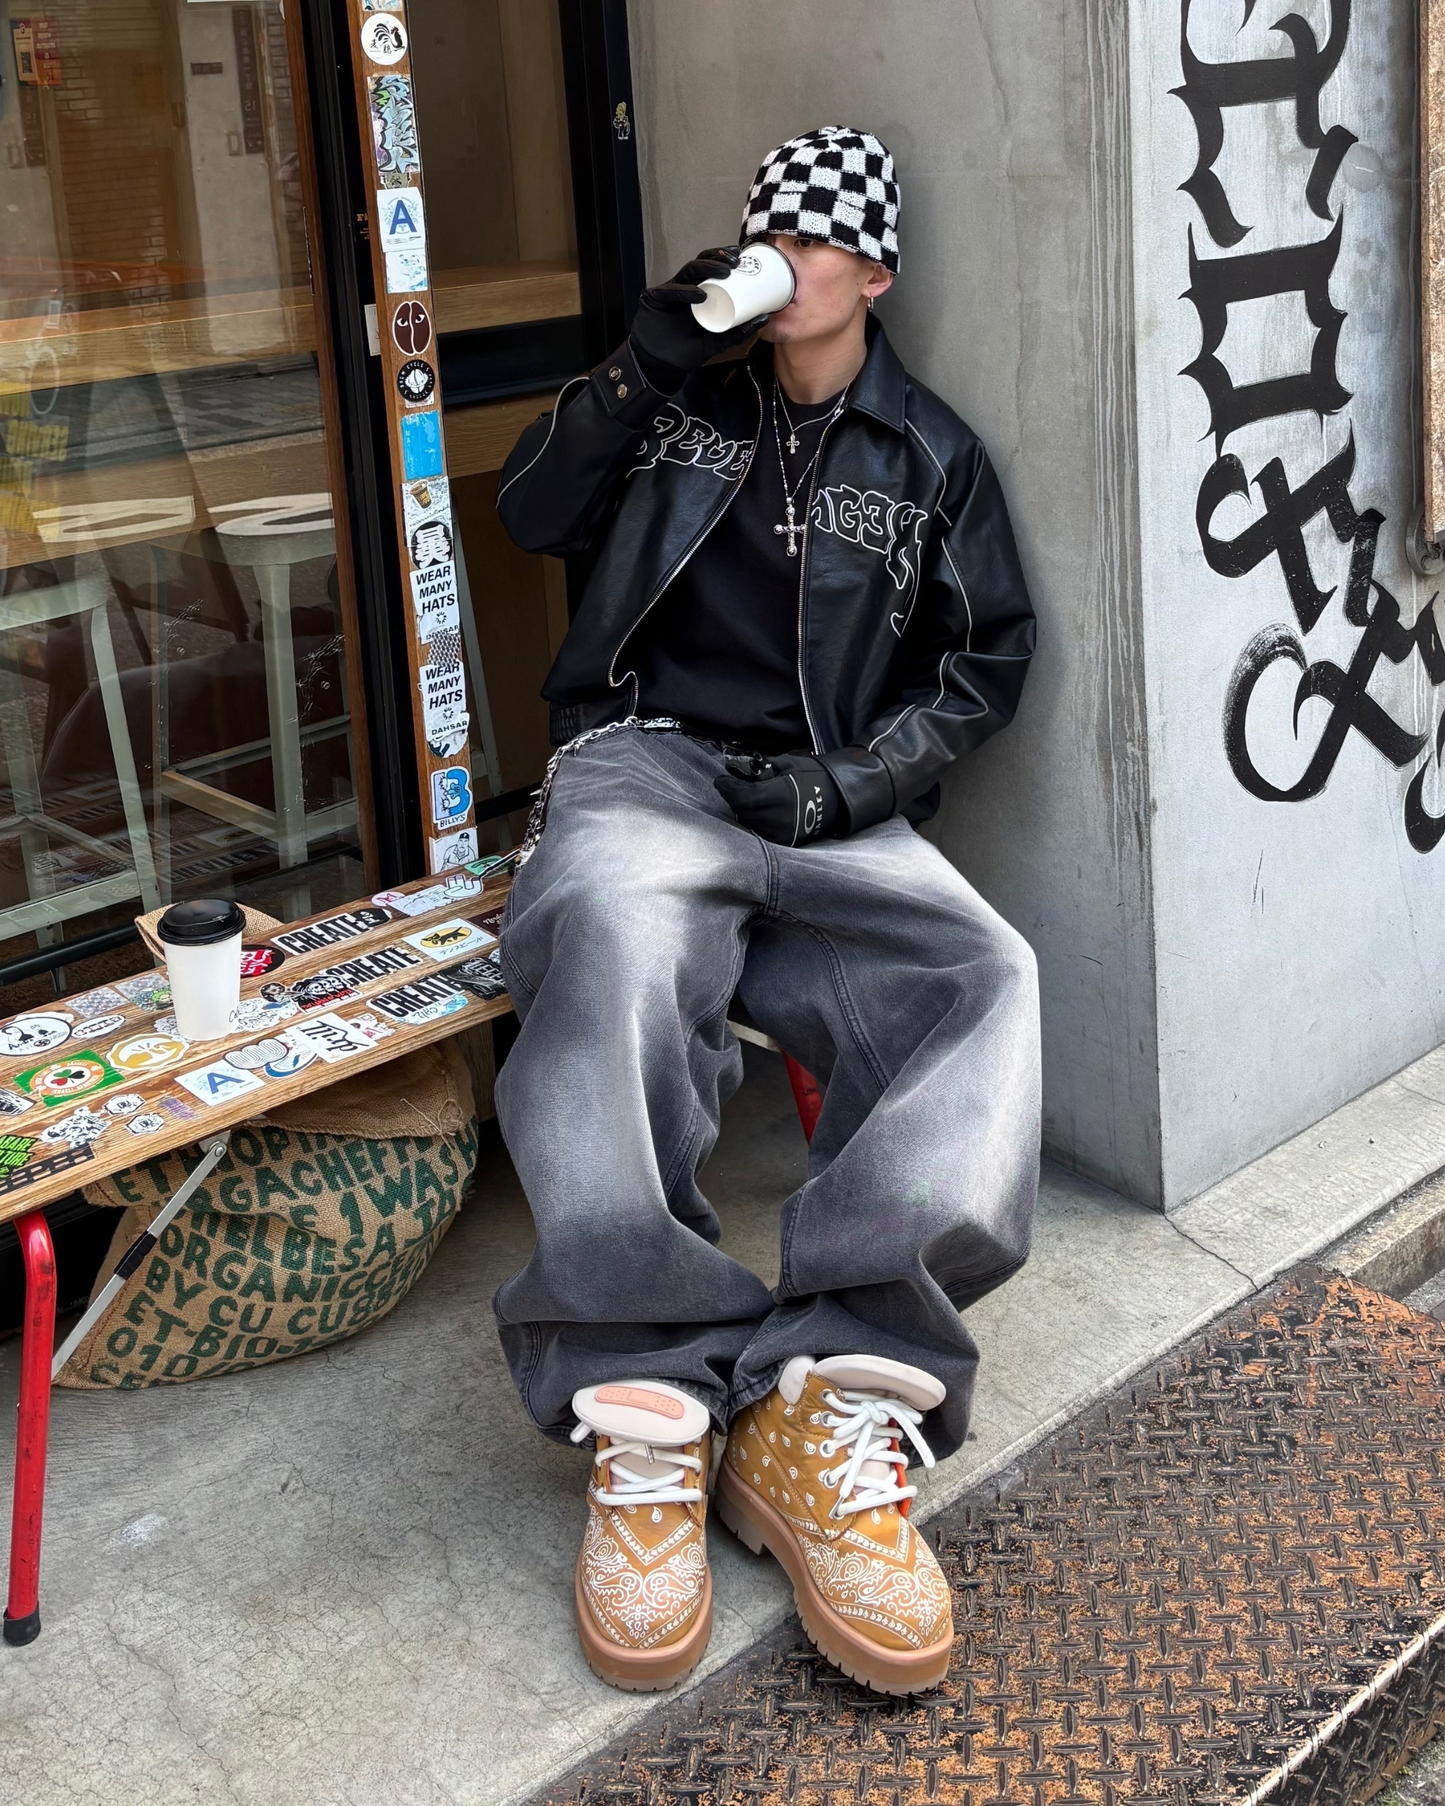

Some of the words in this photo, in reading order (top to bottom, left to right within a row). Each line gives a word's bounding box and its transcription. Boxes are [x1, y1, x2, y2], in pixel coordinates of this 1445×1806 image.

[389, 200, 417, 235] A
[416, 565, 451, 585] WEAR
[419, 579, 452, 599] MANY
[422, 593, 455, 614] HATS
[425, 661, 460, 681] WEAR
[428, 675, 461, 694] MANY
[429, 689, 463, 710] HATS
[431, 720, 467, 735] DAHSAR
[439, 813, 466, 828] BILLY'S
[277, 915, 370, 954] CREATE
[325, 945, 420, 988] CREATE
[206, 1072, 245, 1095] A
[158, 1220, 369, 1304] ORGANIC
[145, 1256, 206, 1310] BY
[208, 1294, 272, 1336] CU
